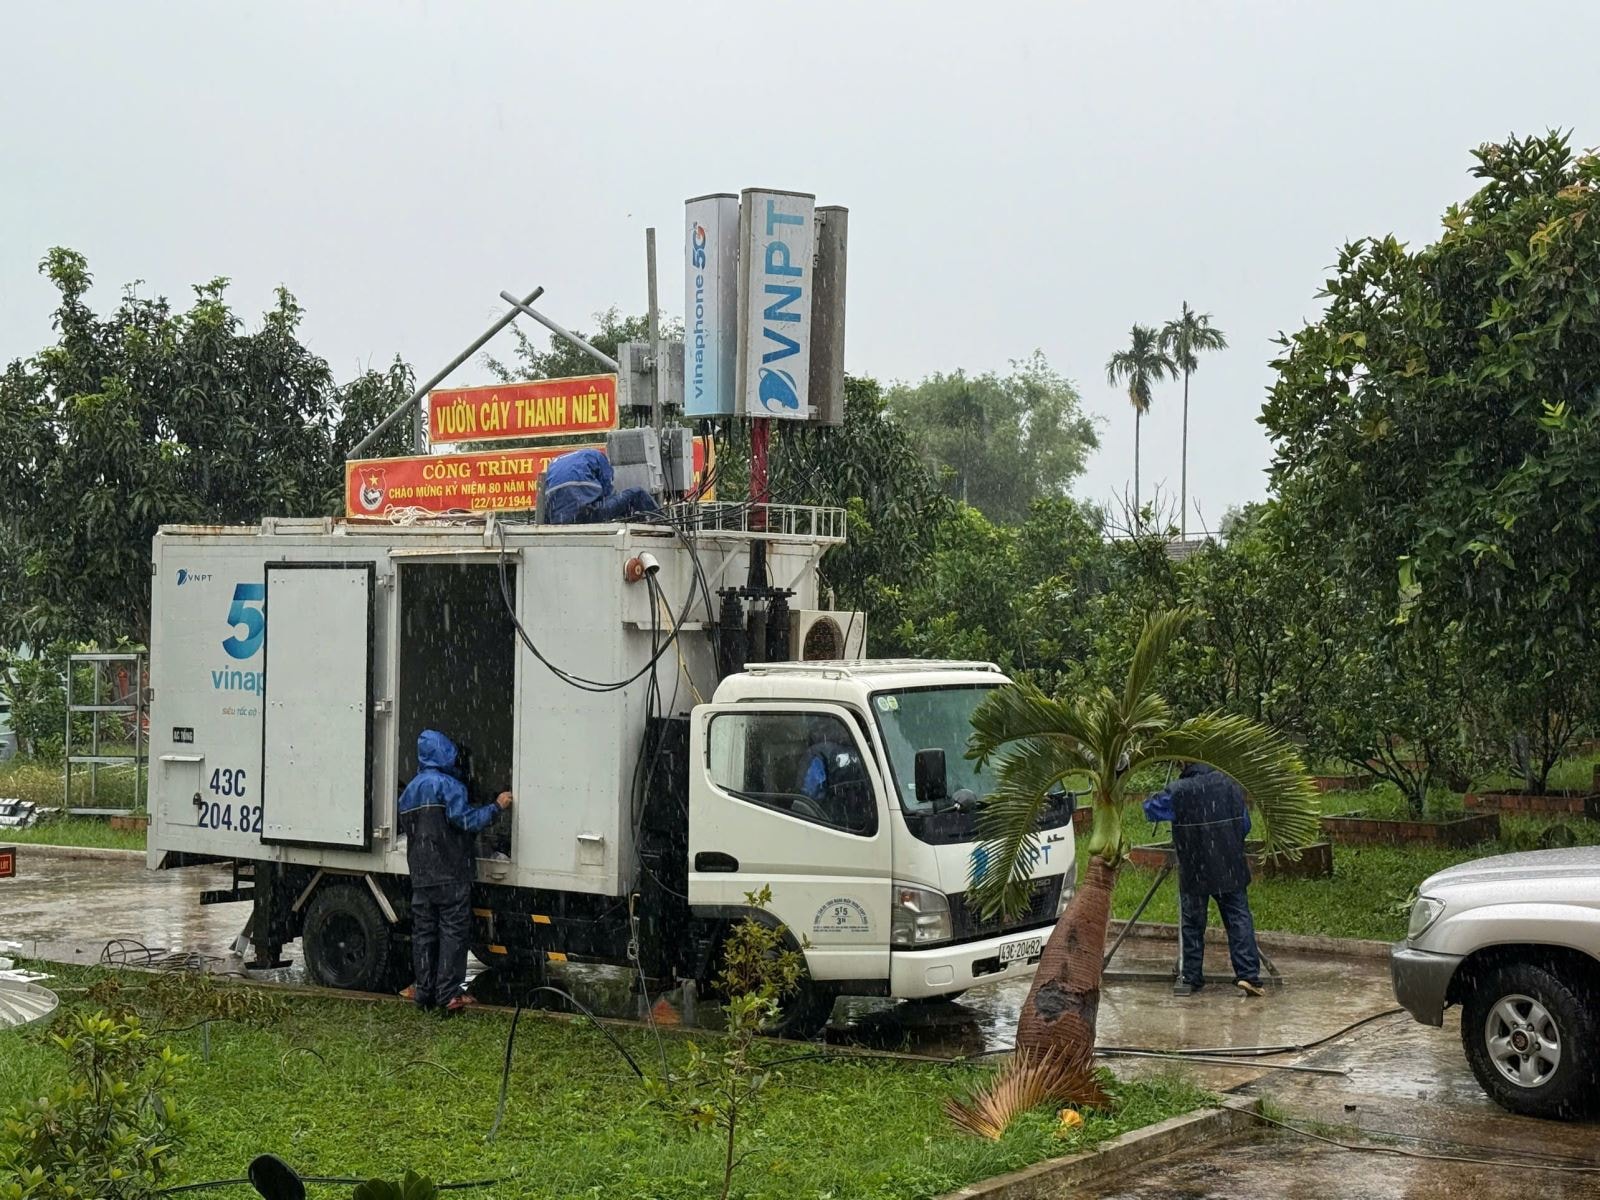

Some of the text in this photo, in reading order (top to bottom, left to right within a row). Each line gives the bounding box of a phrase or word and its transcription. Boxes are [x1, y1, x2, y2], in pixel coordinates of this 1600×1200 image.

[762, 199, 805, 365] VNPT
[693, 275, 704, 399] vinaphone
[436, 386, 609, 434] VƯỜN CÂY THANH NIÊN
[422, 460, 471, 480] CÔNG
[476, 456, 533, 476] TRÌNH
[461, 481, 486, 497] NIỆM
[489, 482, 501, 494] 80
[503, 478, 525, 493] NĂM
[188, 574, 213, 582] VNPT
[222, 583, 265, 660] 5
[211, 664, 264, 697] vinap
[209, 768, 246, 797] 43C
[199, 801, 262, 833] 204.82
